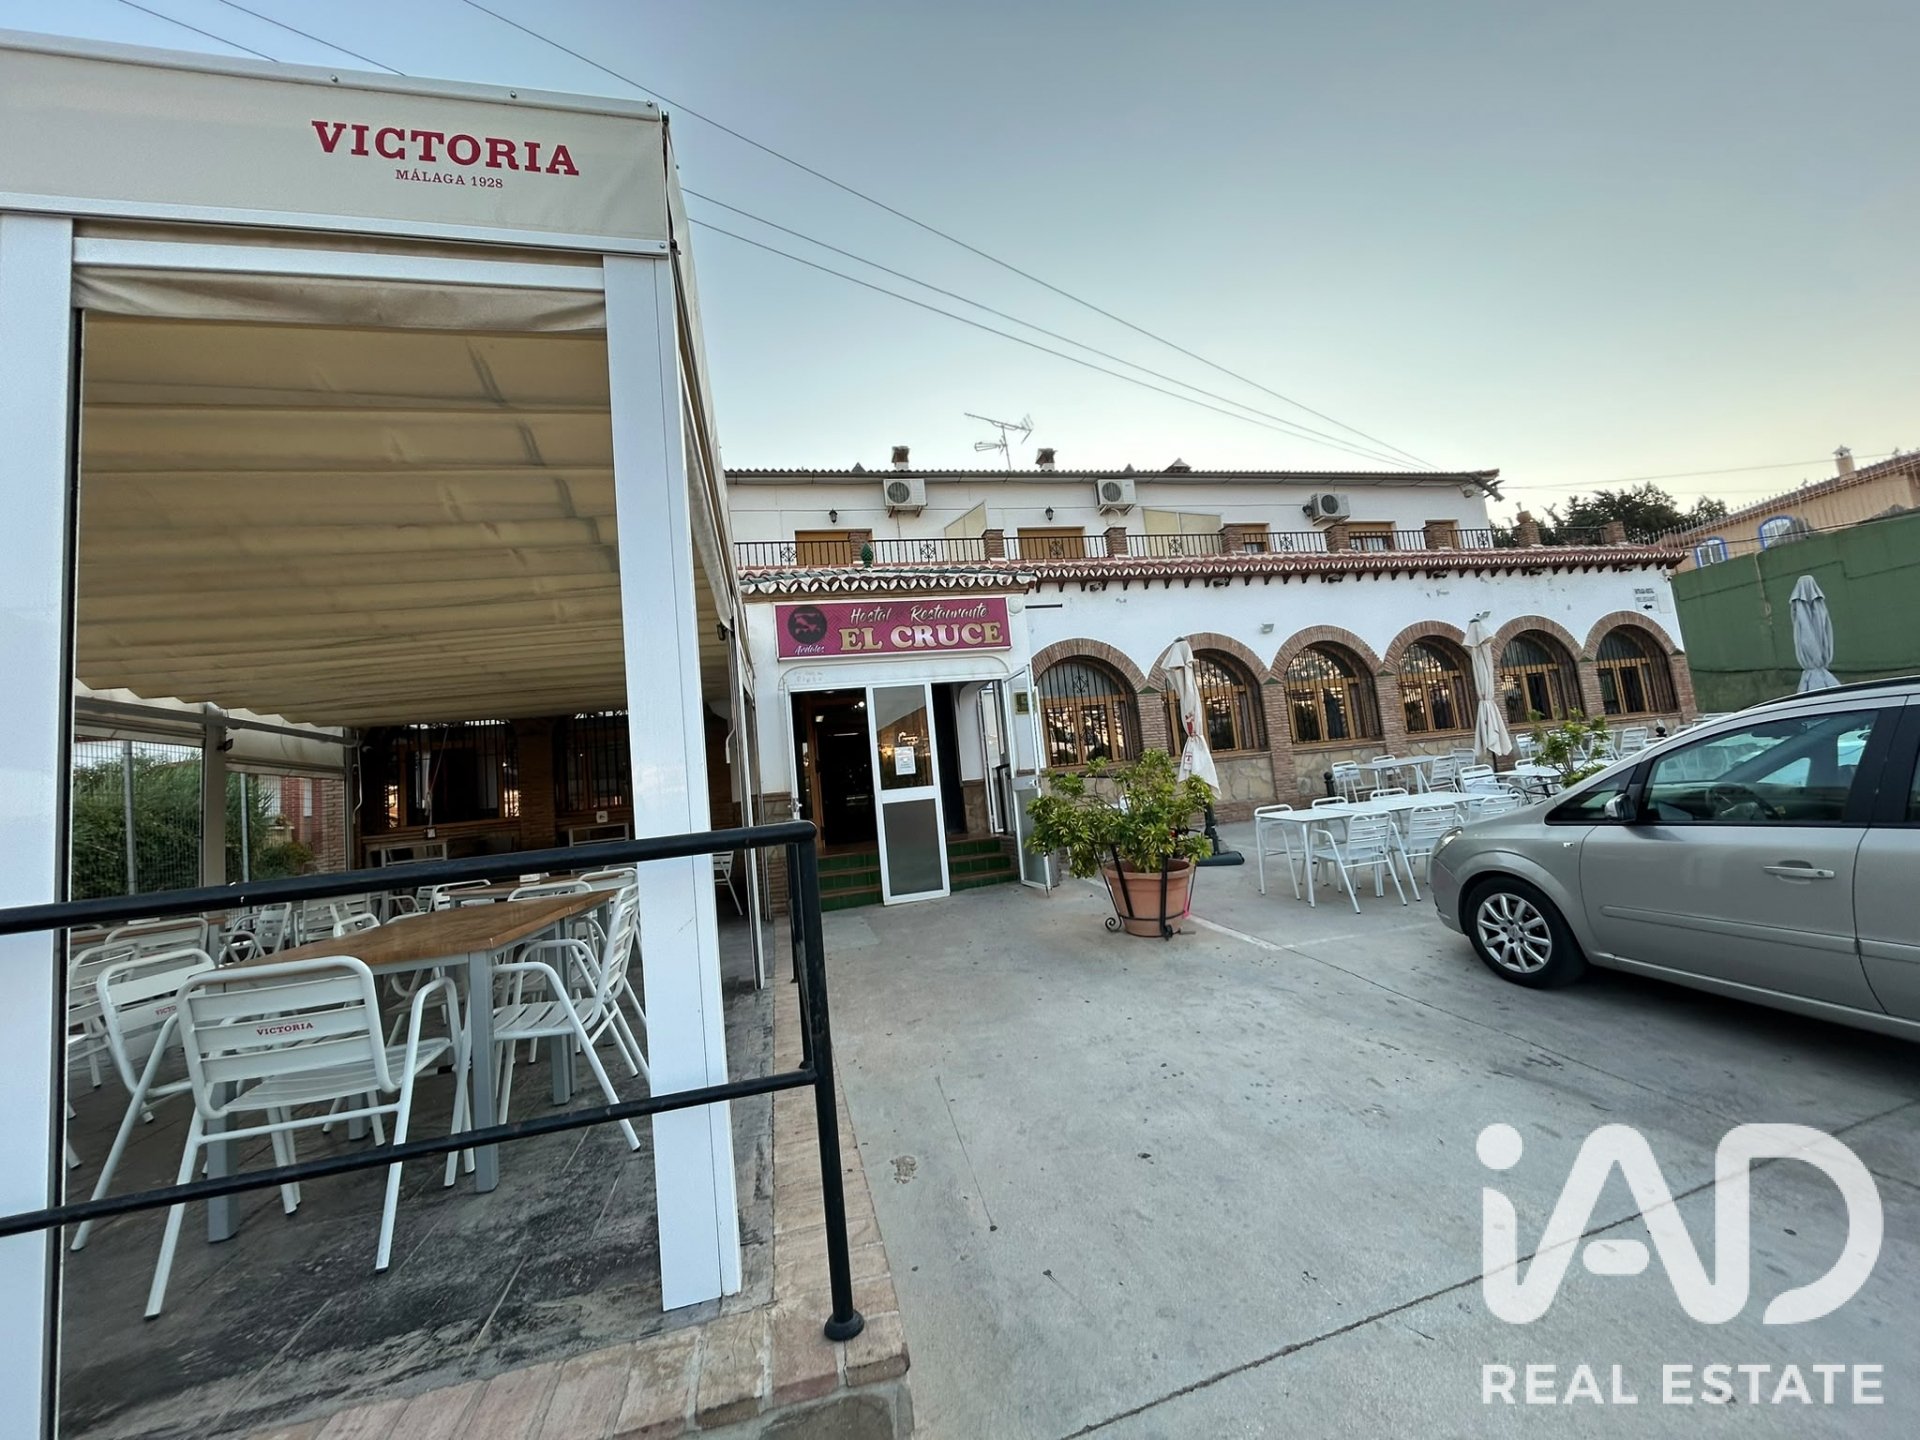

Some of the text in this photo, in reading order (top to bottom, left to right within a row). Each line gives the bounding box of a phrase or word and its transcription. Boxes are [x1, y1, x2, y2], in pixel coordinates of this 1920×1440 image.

[311, 120, 580, 176] VICTORIA
[395, 168, 503, 189] MÁLAGA 1928
[850, 603, 988, 625] Hostal Restaurante
[839, 622, 1003, 651] EL CRUCE
[256, 1022, 314, 1036] VICTORIA
